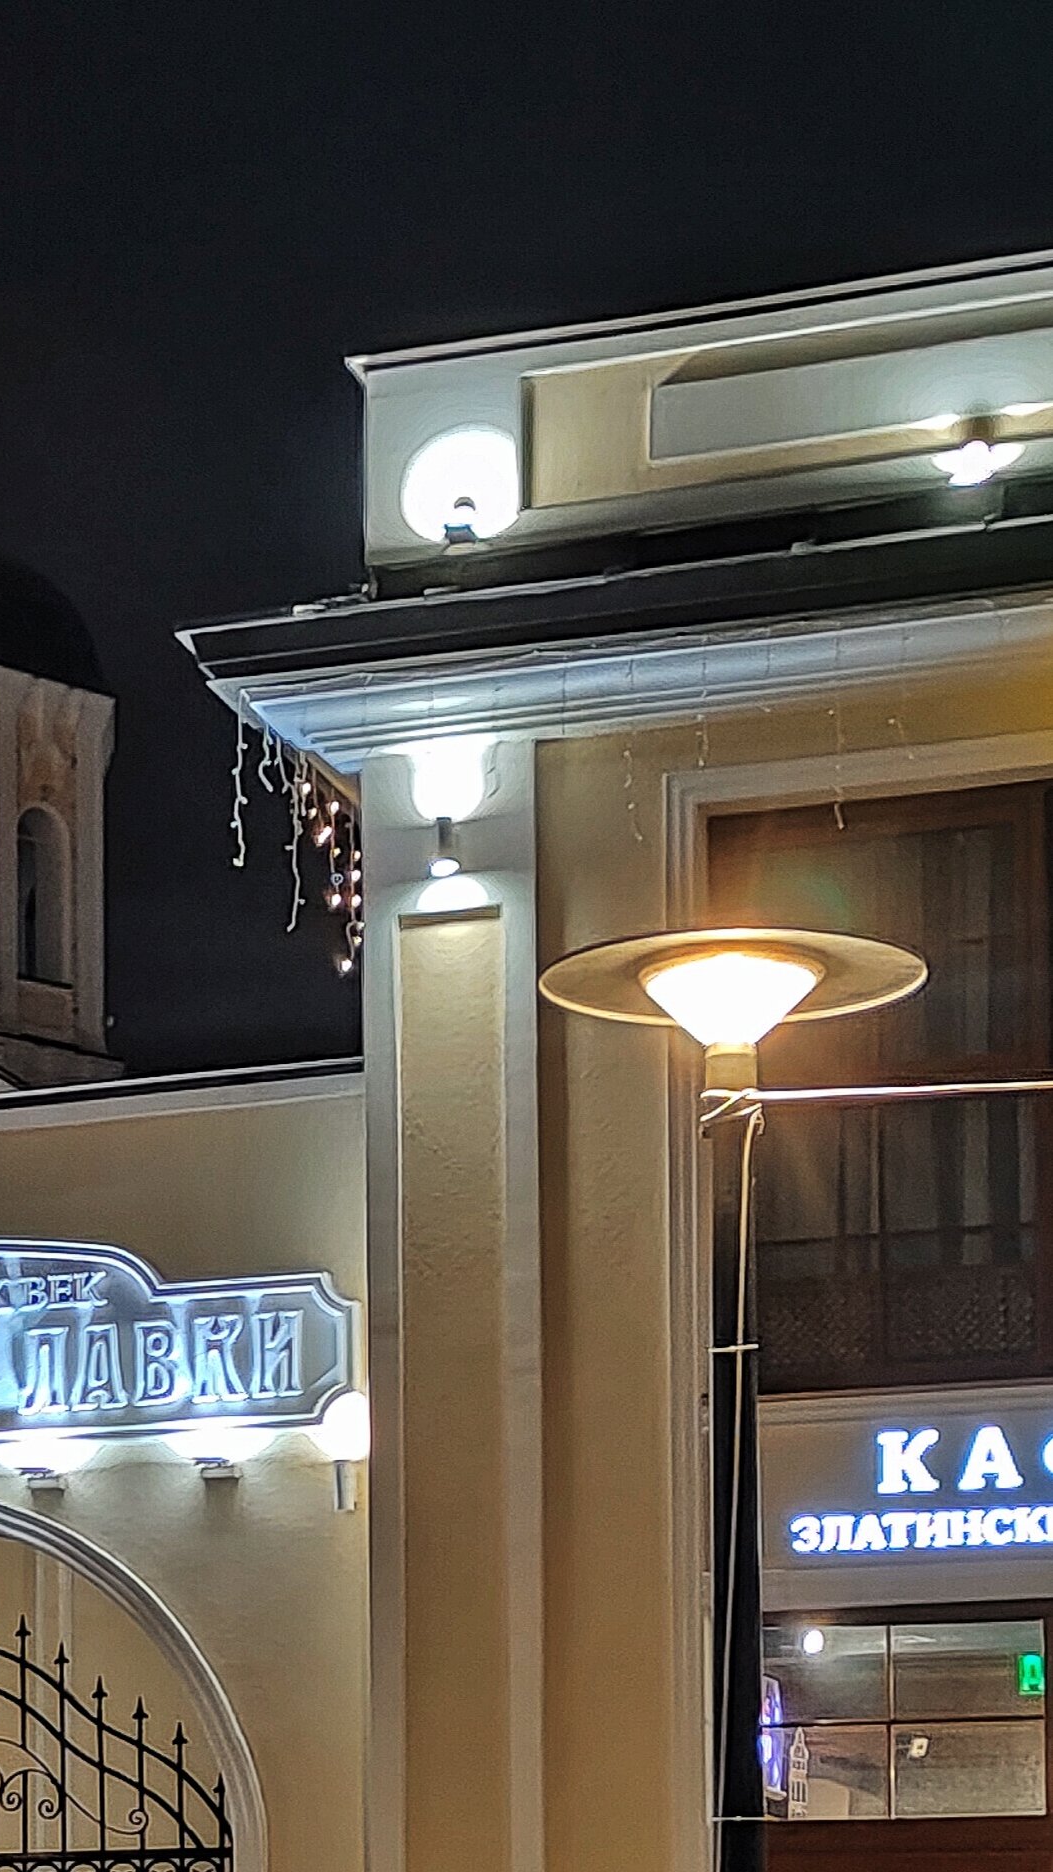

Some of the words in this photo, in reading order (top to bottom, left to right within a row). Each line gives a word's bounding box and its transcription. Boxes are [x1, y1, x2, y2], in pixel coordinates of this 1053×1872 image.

[17, 1271, 109, 1313] ВЕК
[17, 1309, 304, 1416] ЛАВКИ
[877, 1425, 1053, 1494] КА
[790, 1505, 1053, 1552] ЗЛАТИНСК
